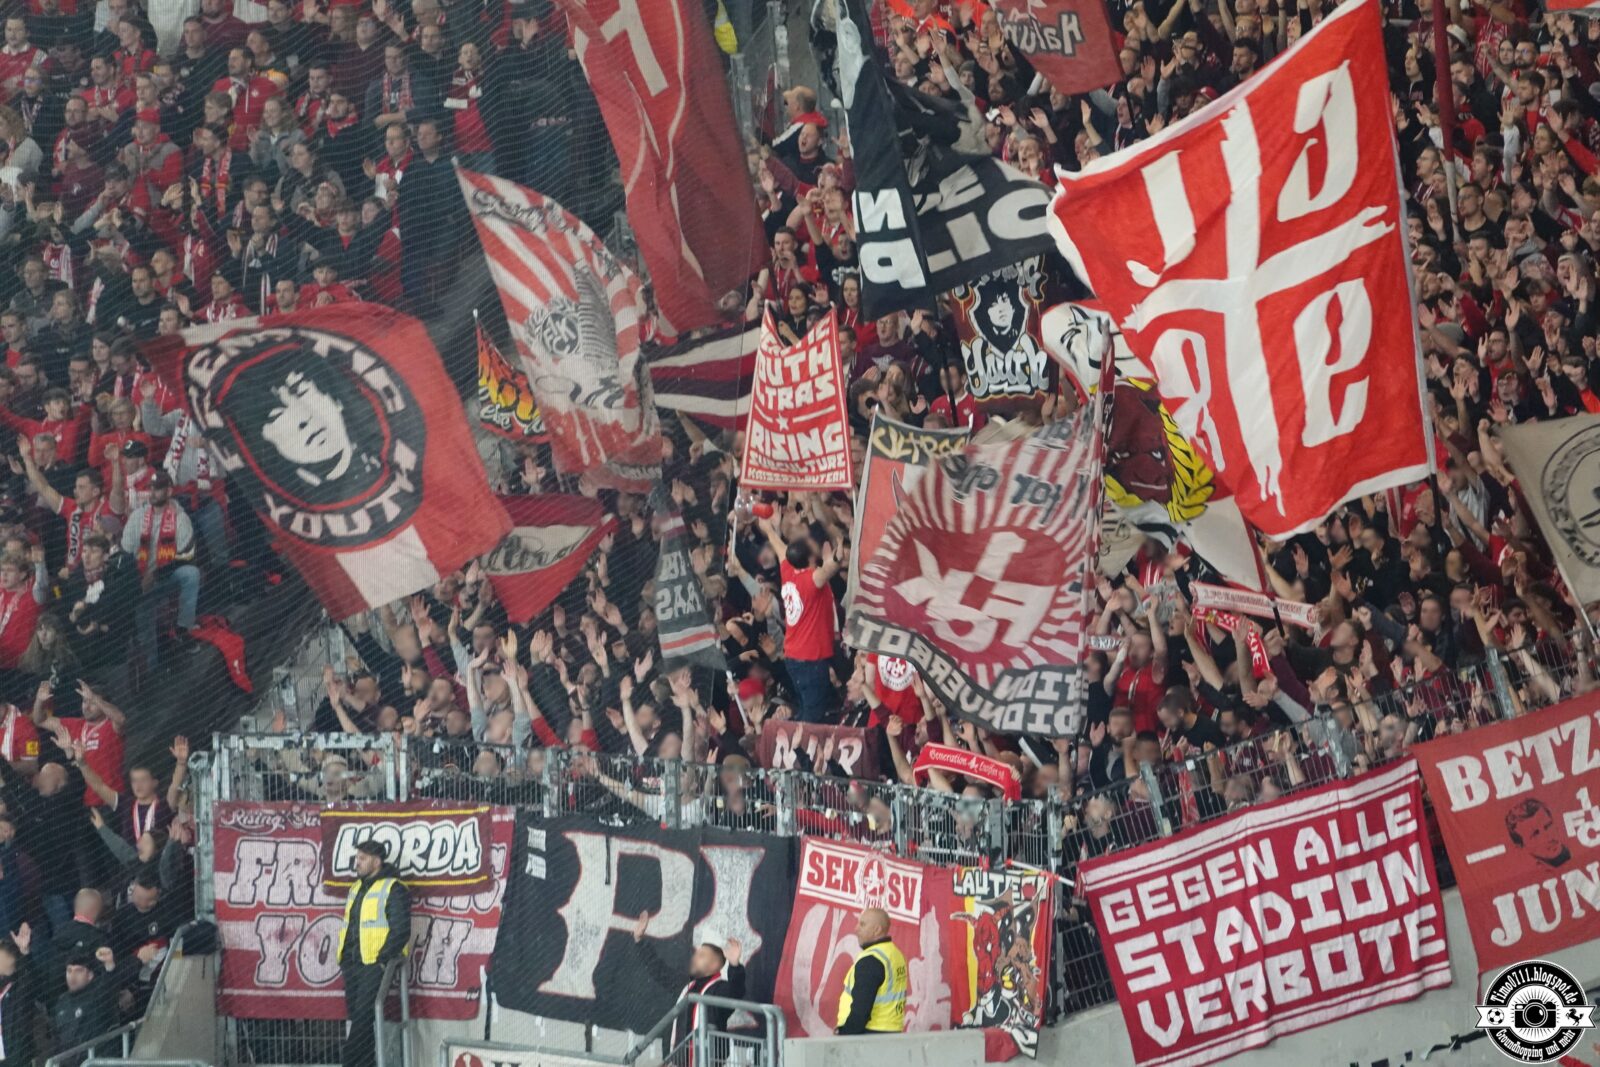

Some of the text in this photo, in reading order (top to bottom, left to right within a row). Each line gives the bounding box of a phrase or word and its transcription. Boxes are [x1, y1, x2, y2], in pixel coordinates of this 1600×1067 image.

[755, 371, 837, 412] LTRAS
[757, 339, 833, 387] OUTH
[750, 420, 845, 462] RISING
[1435, 709, 1600, 813] BETZ
[219, 808, 286, 836] Rising
[807, 850, 919, 912] SEK SV
[1099, 792, 1418, 934] GEGEN ALLE
[1114, 841, 1430, 993] STADION
[1138, 904, 1446, 1048] VERBOTE
